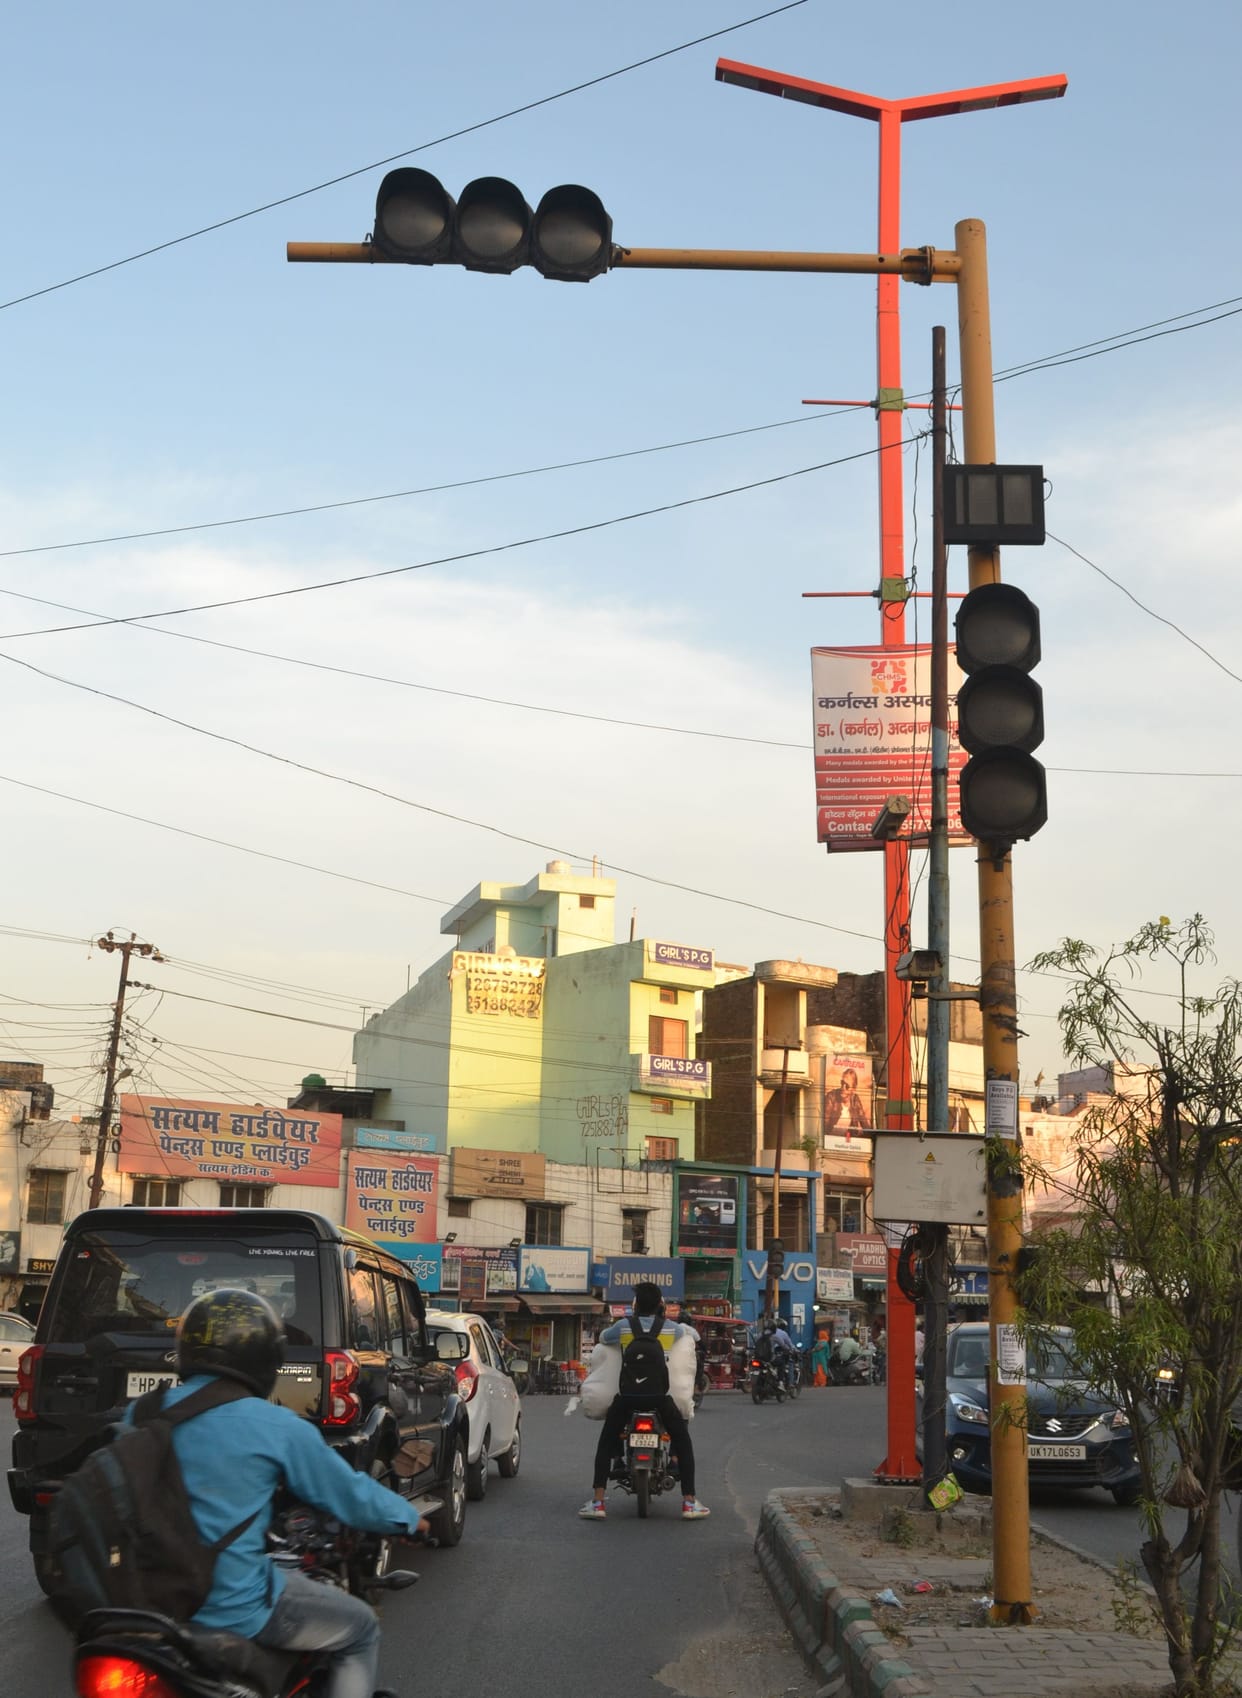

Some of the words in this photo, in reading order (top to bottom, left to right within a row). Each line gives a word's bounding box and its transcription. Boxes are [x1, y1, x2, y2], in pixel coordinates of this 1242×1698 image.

[817, 691, 879, 709] कर्नल्स
[840, 718, 883, 740] (कर्नल)
[828, 821, 873, 831] Contac
[658, 946, 690, 961] GIRL'S
[691, 951, 710, 963] P.G
[653, 1058, 685, 1071] GIRL'S
[686, 1062, 704, 1074] P.G
[150, 1106, 221, 1134] सत्यम
[230, 1109, 320, 1143] हार्डवेयर
[211, 1140, 246, 1159] एण्ड
[251, 1142, 311, 1170] प्लाईवुड
[199, 1163, 228, 1174] सत्यम
[354, 1167, 388, 1190] सत्यम
[399, 1199, 424, 1214] एण्ड
[367, 1216, 416, 1238] प्लाईवुड
[32, 1261, 54, 1272] SHY
[614, 1272, 673, 1287] SAMSUNG
